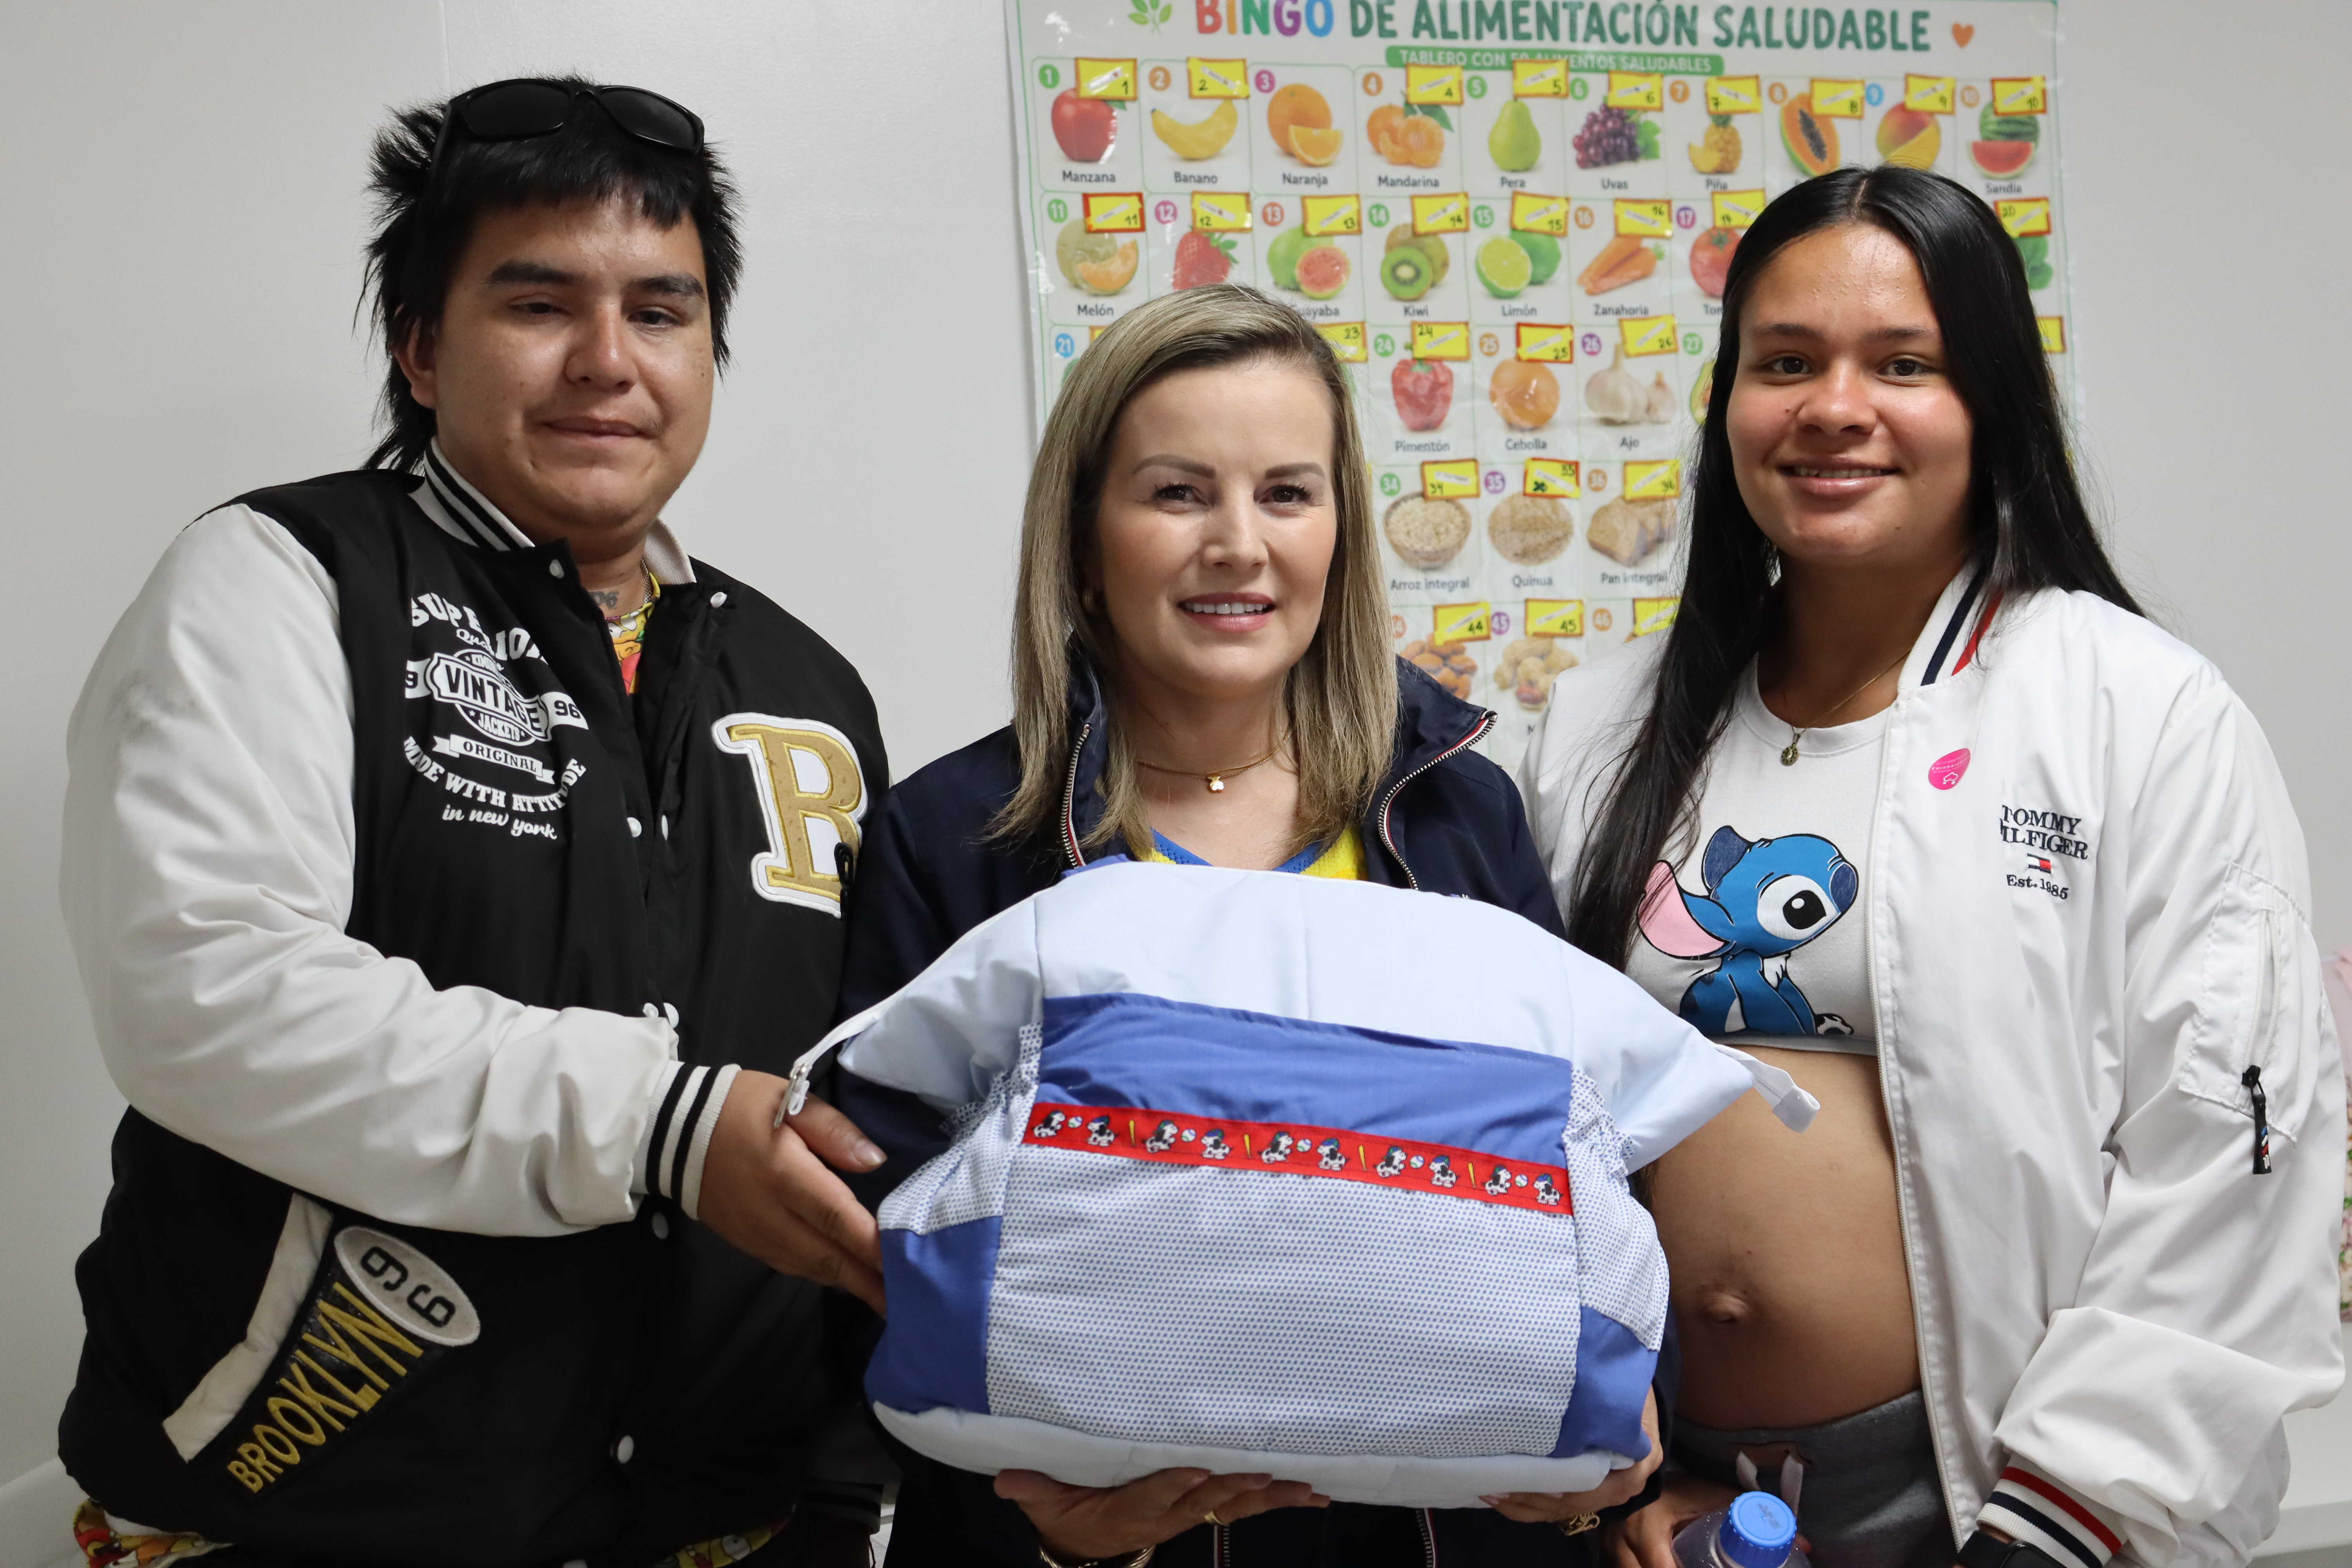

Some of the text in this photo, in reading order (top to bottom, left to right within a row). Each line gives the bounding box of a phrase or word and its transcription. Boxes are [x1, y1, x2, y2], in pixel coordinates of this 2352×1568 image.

[1196, 0, 1931, 51] BINGO DE ALIMENTACIÓN SALUDABLE
[1399, 49, 1467, 65] TABLERO
[1472, 52, 1506, 66] CON
[1620, 56, 1711, 72] SALUDABLES
[1045, 69, 1053, 83] 1
[1154, 71, 1165, 86] 2
[1260, 74, 1270, 89] 3
[1198, 80, 1208, 91] 2
[1472, 81, 1482, 94] 5
[1553, 80, 1562, 94] 5
[1574, 82, 1584, 95] 6
[1675, 85, 1685, 98] 7
[1445, 87, 1453, 98] 4
[1646, 92, 1655, 103] 6
[1063, 172, 1116, 183] Manzana
[1174, 172, 1218, 184] Banano
[1282, 173, 1328, 186] Naranja
[1378, 175, 1439, 187] Mandarina
[1501, 177, 1525, 188] Pera
[1602, 178, 1628, 189] Uvas
[1706, 179, 1728, 190] Piña
[1051, 204, 1064, 218] 11
[1158, 206, 1175, 220] 12
[1265, 208, 1282, 220] 13
[1372, 209, 1387, 221] 14
[1476, 210, 1491, 223] 15
[1653, 205, 1664, 216] 16
[1679, 211, 1694, 223] 17
[2002, 205, 2015, 217] 20
[1125, 214, 1138, 226] 11
[1200, 216, 1212, 226] 12
[1451, 214, 1463, 227] 14
[1548, 219, 1563, 231] 15
[1078, 305, 1113, 316] Melón
[1404, 306, 1428, 316] Kiwi
[1502, 305, 1537, 316] Limón
[1594, 304, 1649, 316] Zanahoria
[1344, 326, 1359, 339] 23
[1418, 325, 1433, 338] 24
[1058, 338, 1071, 352] 21
[1376, 339, 1394, 352] 24
[1481, 338, 1497, 351] 25
[1584, 338, 1600, 351] 26
[1659, 338, 1672, 348] 26
[1685, 338, 1701, 350] 27
[1554, 348, 1568, 360] 25
[1395, 440, 1450, 452] Pimentón
[1506, 439, 1547, 450] Cebolla
[1621, 437, 1639, 451] Ajo
[1382, 478, 1399, 492] 34
[1430, 483, 1444, 494] 34
[1486, 475, 1503, 490] 35
[1391, 577, 1470, 592] Arroz integral
[1513, 575, 1553, 587] Quinua
[1602, 572, 1667, 586] Pan integral
[1469, 621, 1483, 634] 44
[1493, 617, 1508, 629] 45
[1561, 620, 1576, 633] 45
[445, 664, 542, 732] VINTAGE
[554, 700, 581, 719] 96
[478, 713, 521, 741] JACKETS
[463, 741, 536, 773] ORIGINAL
[403, 736, 445, 782] MADE
[445, 772, 506, 808] WITH
[442, 804, 557, 839] in new york
[2002, 805, 2082, 835] TOMMY
[2007, 875, 2069, 899] Est. 1985
[361, 1247, 455, 1327] 96
[227, 1282, 424, 1493] BROOKLYN
